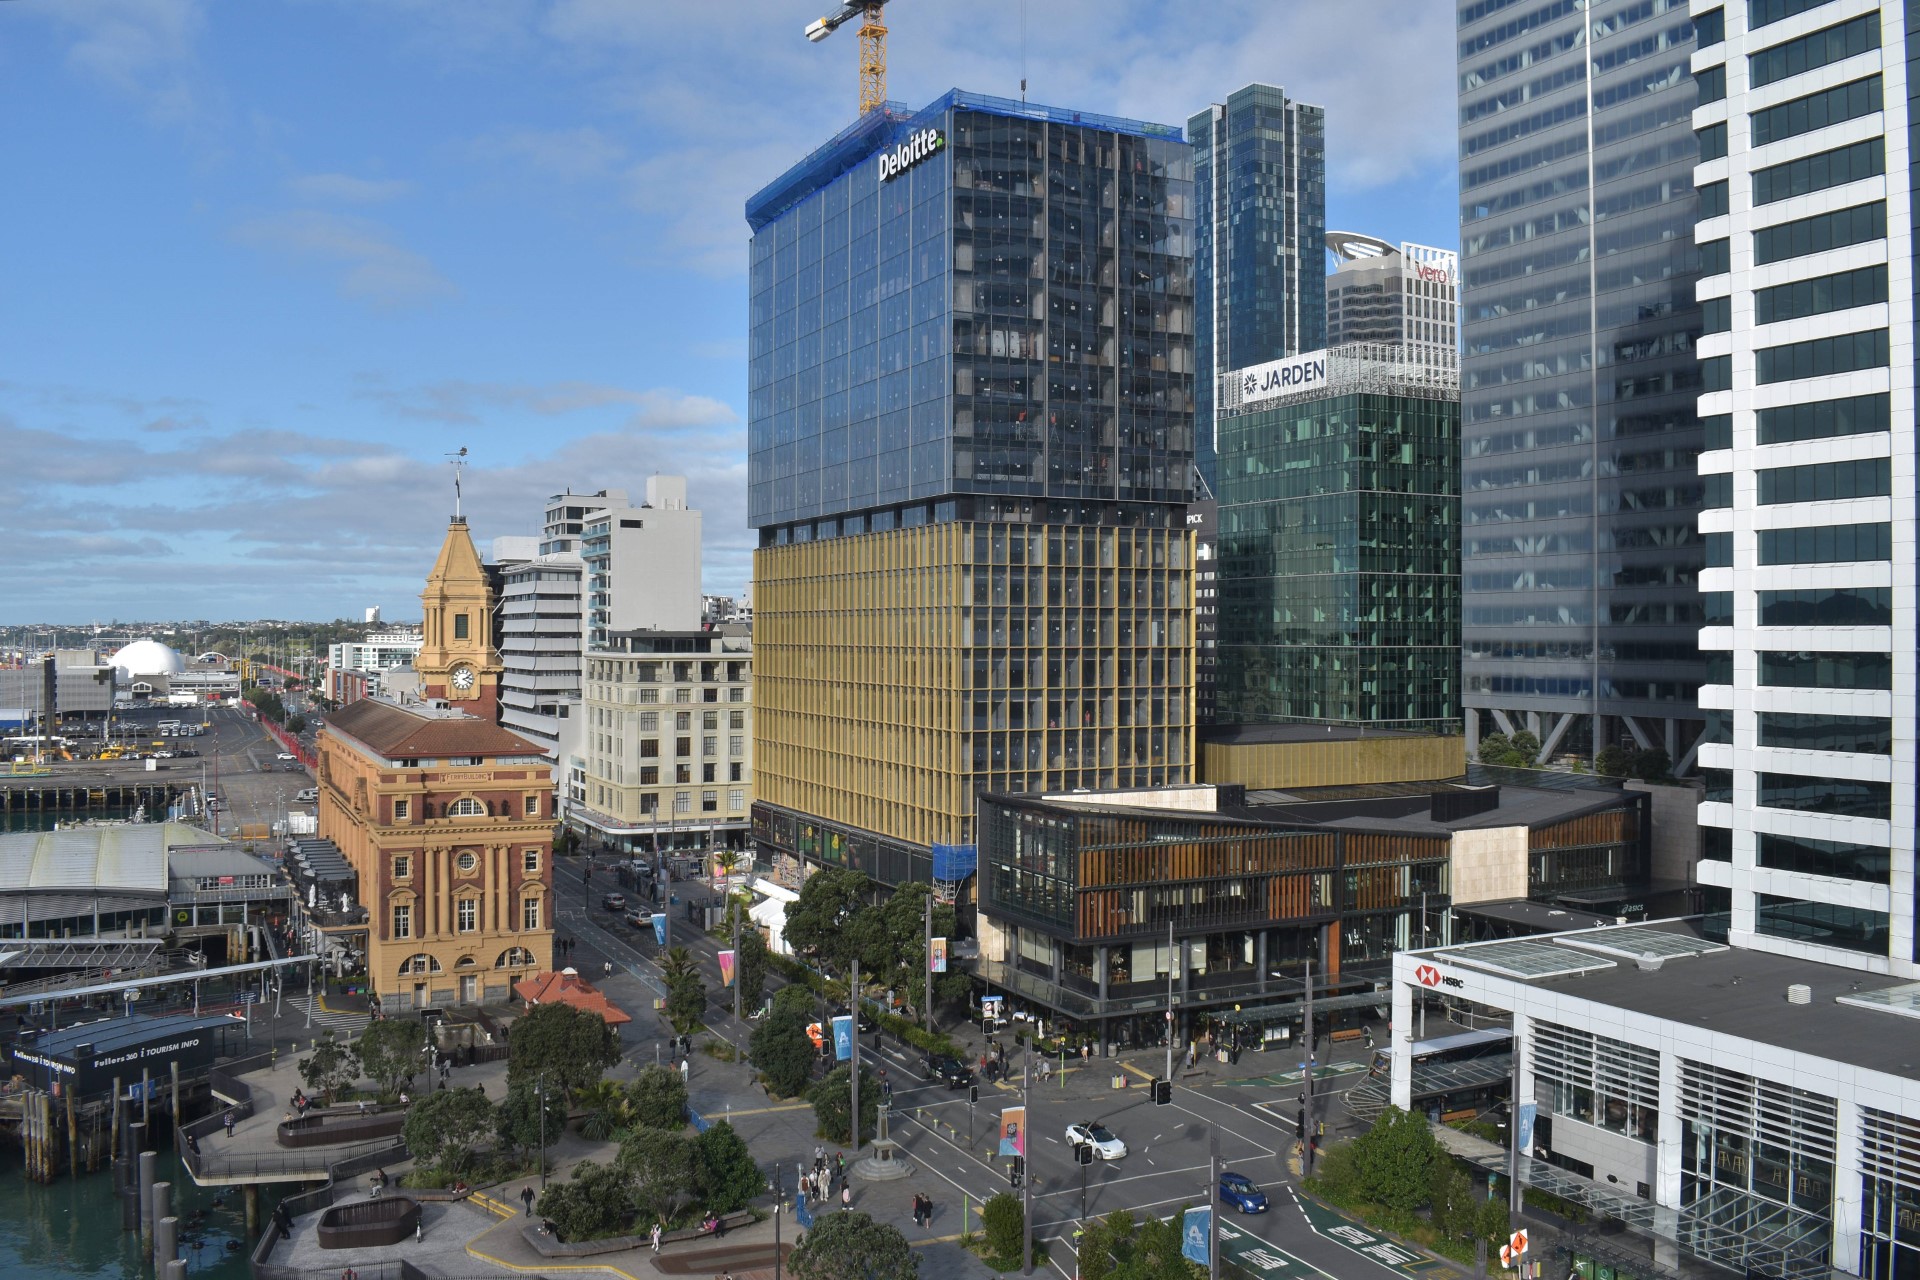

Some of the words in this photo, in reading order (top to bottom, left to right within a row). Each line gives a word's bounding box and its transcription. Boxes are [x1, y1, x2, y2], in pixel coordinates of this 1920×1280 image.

[1415, 264, 1447, 284] vero
[1260, 359, 1325, 391] JARDEN
[1442, 975, 1464, 989] HSBC
[146, 1043, 179, 1057] TOURISM
[181, 1039, 200, 1049] INFO
[63, 1064, 76, 1074] INFO
[1237, 1248, 1290, 1270] BUS
